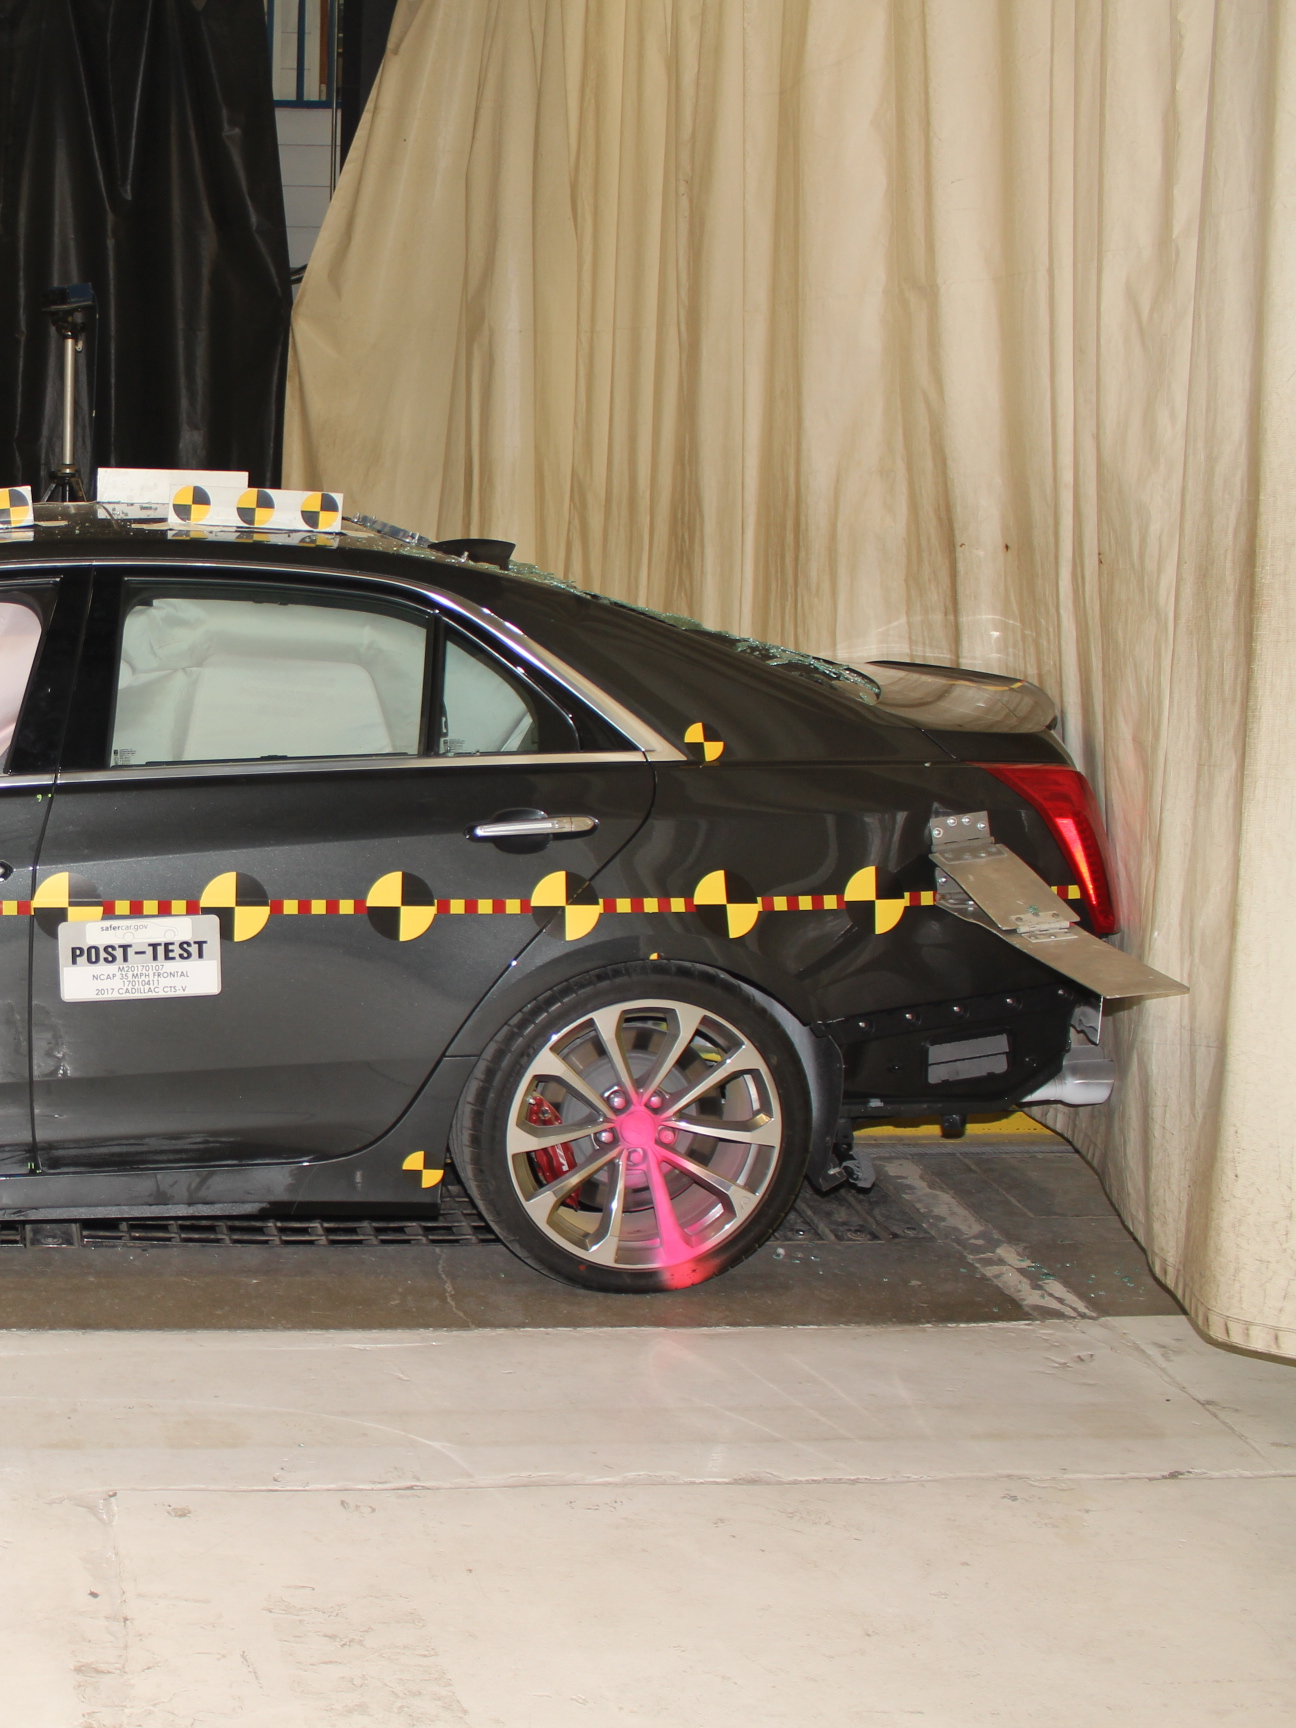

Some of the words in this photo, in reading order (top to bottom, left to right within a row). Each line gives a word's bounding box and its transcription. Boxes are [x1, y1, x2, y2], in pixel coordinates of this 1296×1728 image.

[100, 923, 149, 932] safercar.gov
[71, 941, 208, 966] POST-TEST
[117, 964, 165, 973] M20170107
[92, 973, 117, 982] NCAP
[119, 973, 129, 981] 35
[131, 972, 150, 980] MPH
[152, 970, 190, 979] FRONTAL
[122, 979, 161, 988] 17010411
[95, 988, 115, 996] 2017
[117, 986, 160, 996] CADILLAC
[162, 985, 187, 994] CTS-V
